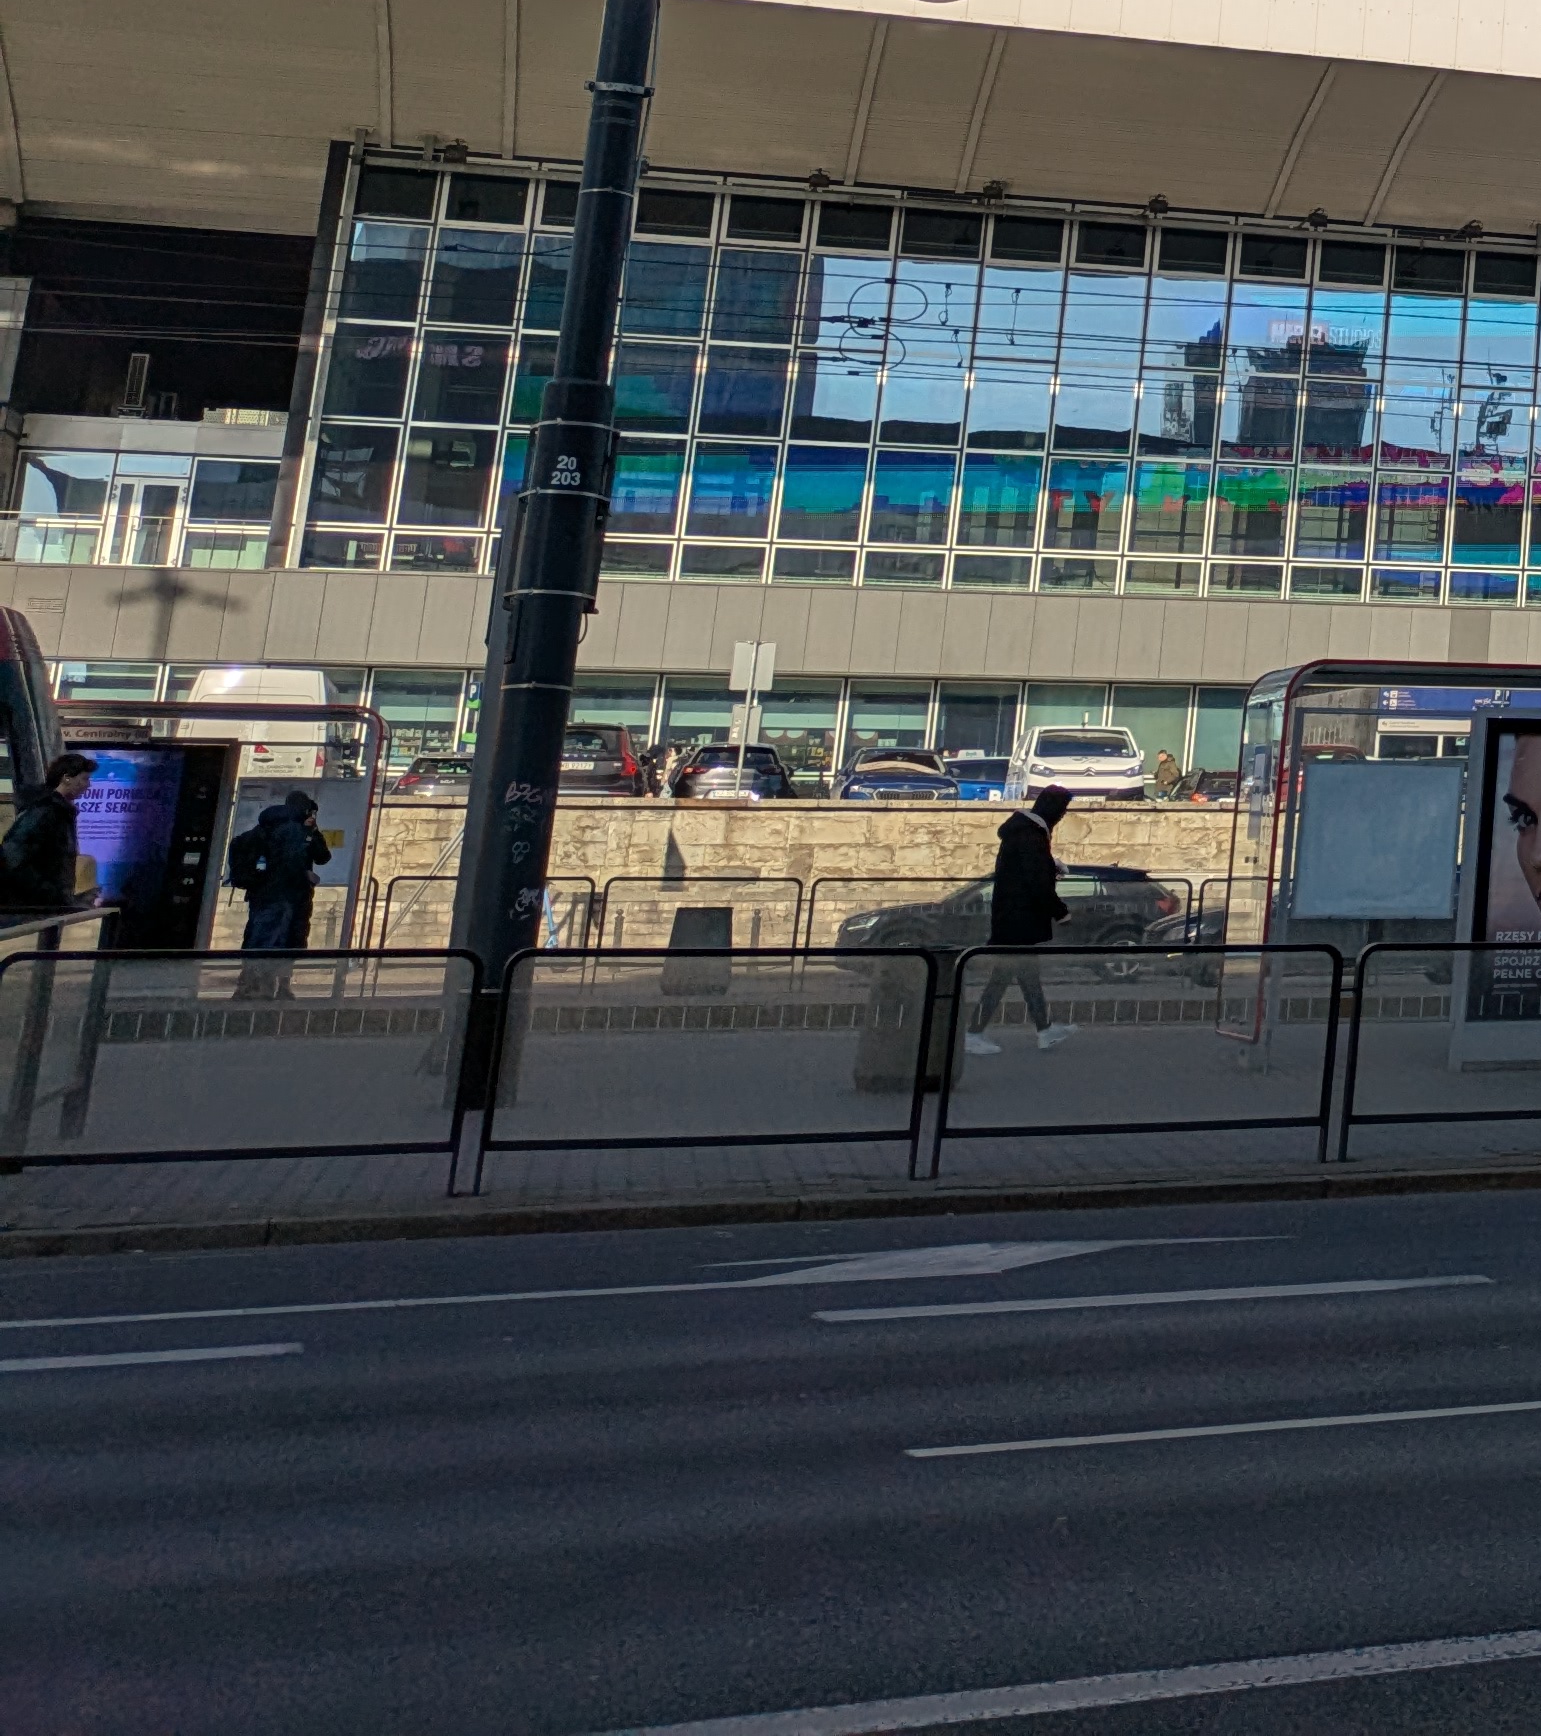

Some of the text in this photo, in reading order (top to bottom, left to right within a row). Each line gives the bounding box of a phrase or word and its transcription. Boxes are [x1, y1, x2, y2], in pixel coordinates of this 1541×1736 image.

[557, 455, 577, 470] 20
[551, 471, 580, 486] 203
[469, 684, 477, 699] P
[1495, 931, 1535, 943] RZĘSY
[1493, 968, 1532, 979] PEŁNE
